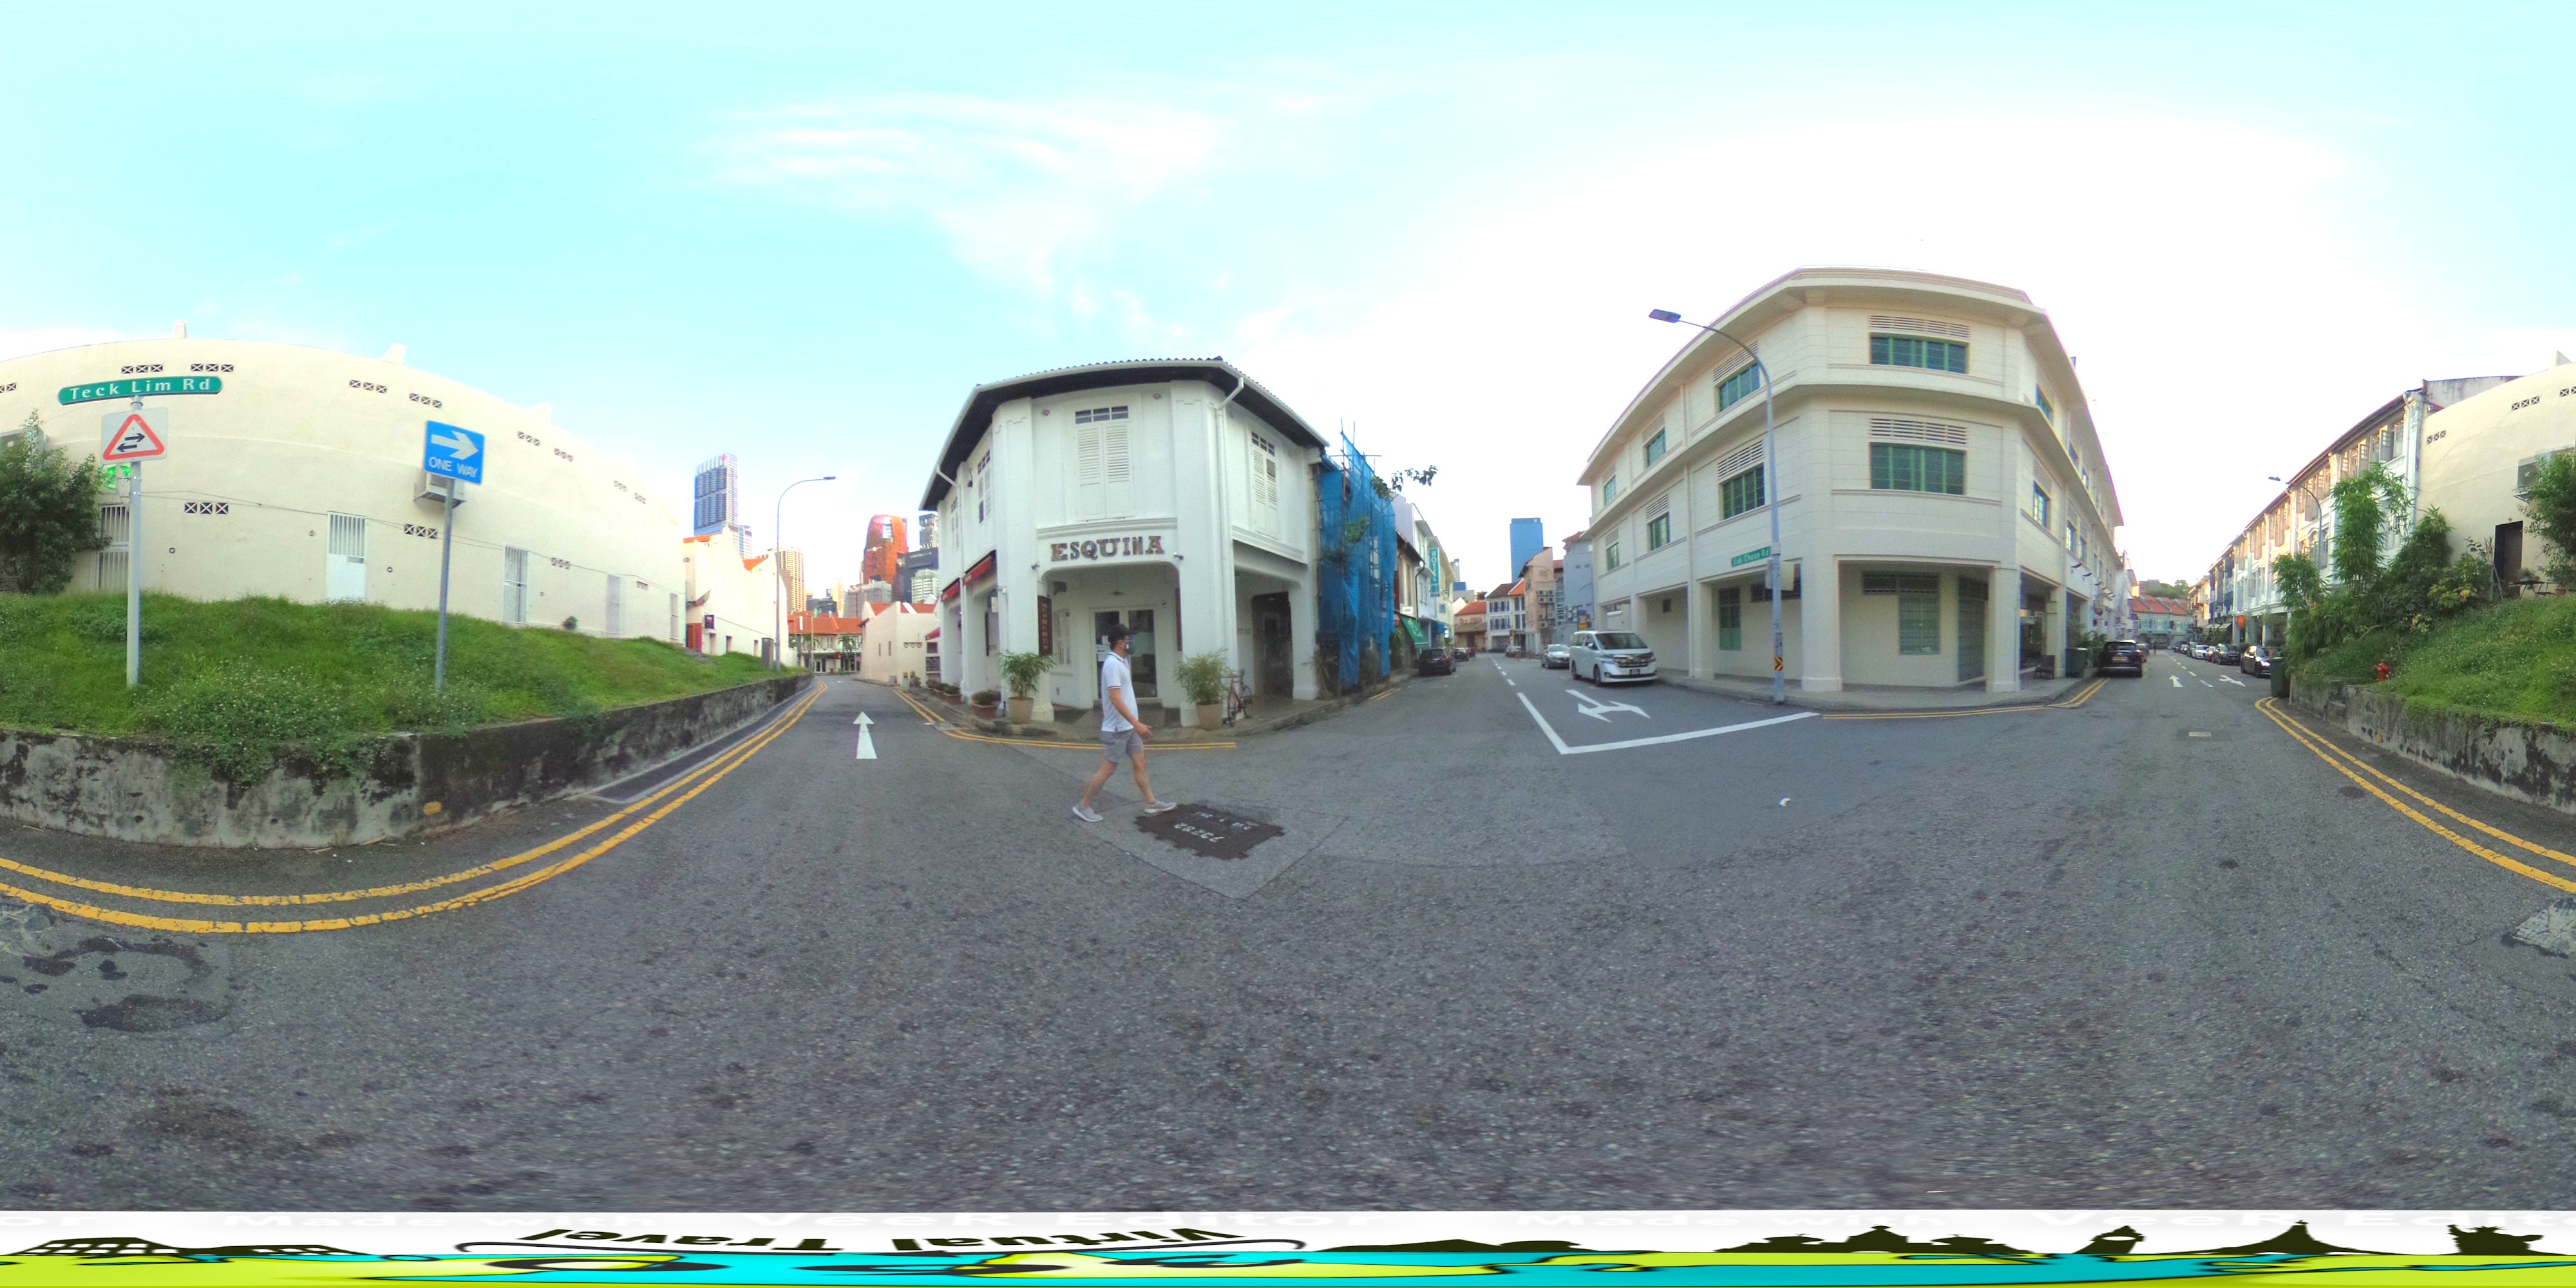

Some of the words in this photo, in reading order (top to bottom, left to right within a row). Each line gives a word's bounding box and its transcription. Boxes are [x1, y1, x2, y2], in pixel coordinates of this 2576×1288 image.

[70, 383, 119, 400] Teck
[131, 380, 171, 393] Lim
[183, 378, 210, 391] Rd
[428, 456, 453, 471] ONE
[457, 462, 479, 478] WAY
[1050, 535, 1165, 562] ESQUINA
